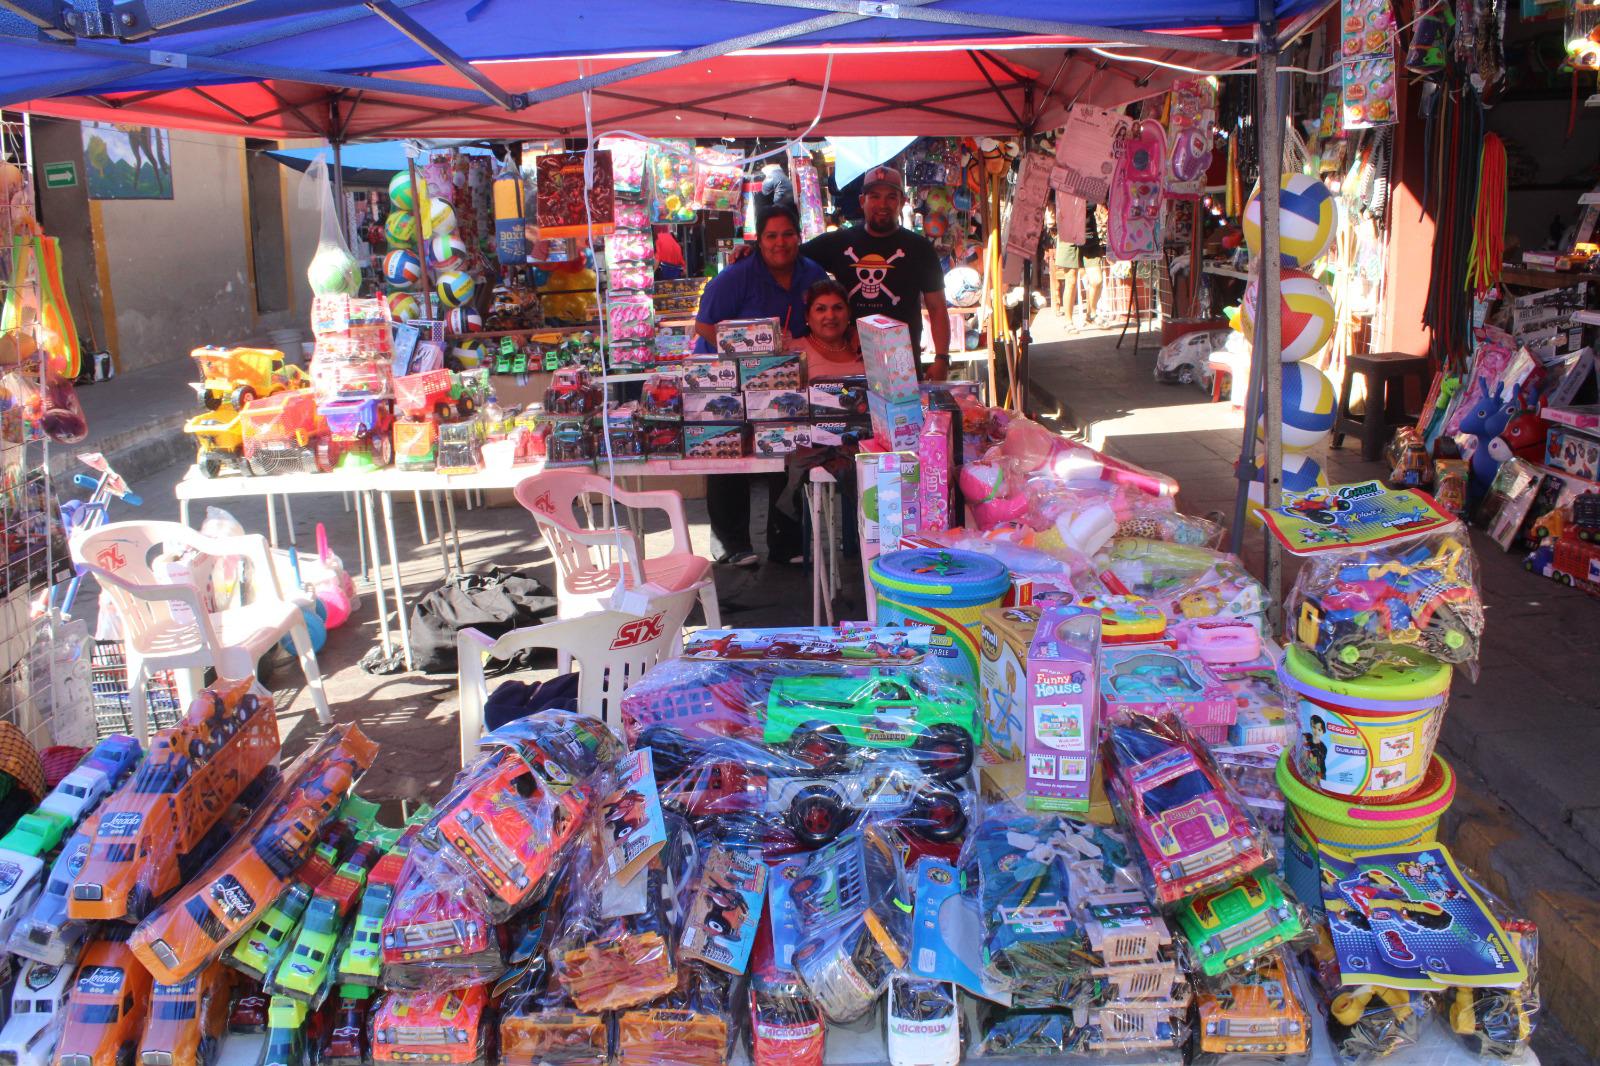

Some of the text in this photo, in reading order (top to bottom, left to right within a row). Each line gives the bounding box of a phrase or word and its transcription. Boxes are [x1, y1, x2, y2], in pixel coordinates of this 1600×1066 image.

[609, 611, 667, 650] SIX
[1036, 673, 1070, 684] Funny
[1035, 683, 1081, 698] House
[1327, 724, 1355, 735] SEGURO
[1336, 746, 1366, 755] DURABLE
[765, 1027, 814, 1037] MICROBUS
[897, 1023, 946, 1034] MICROBUS
